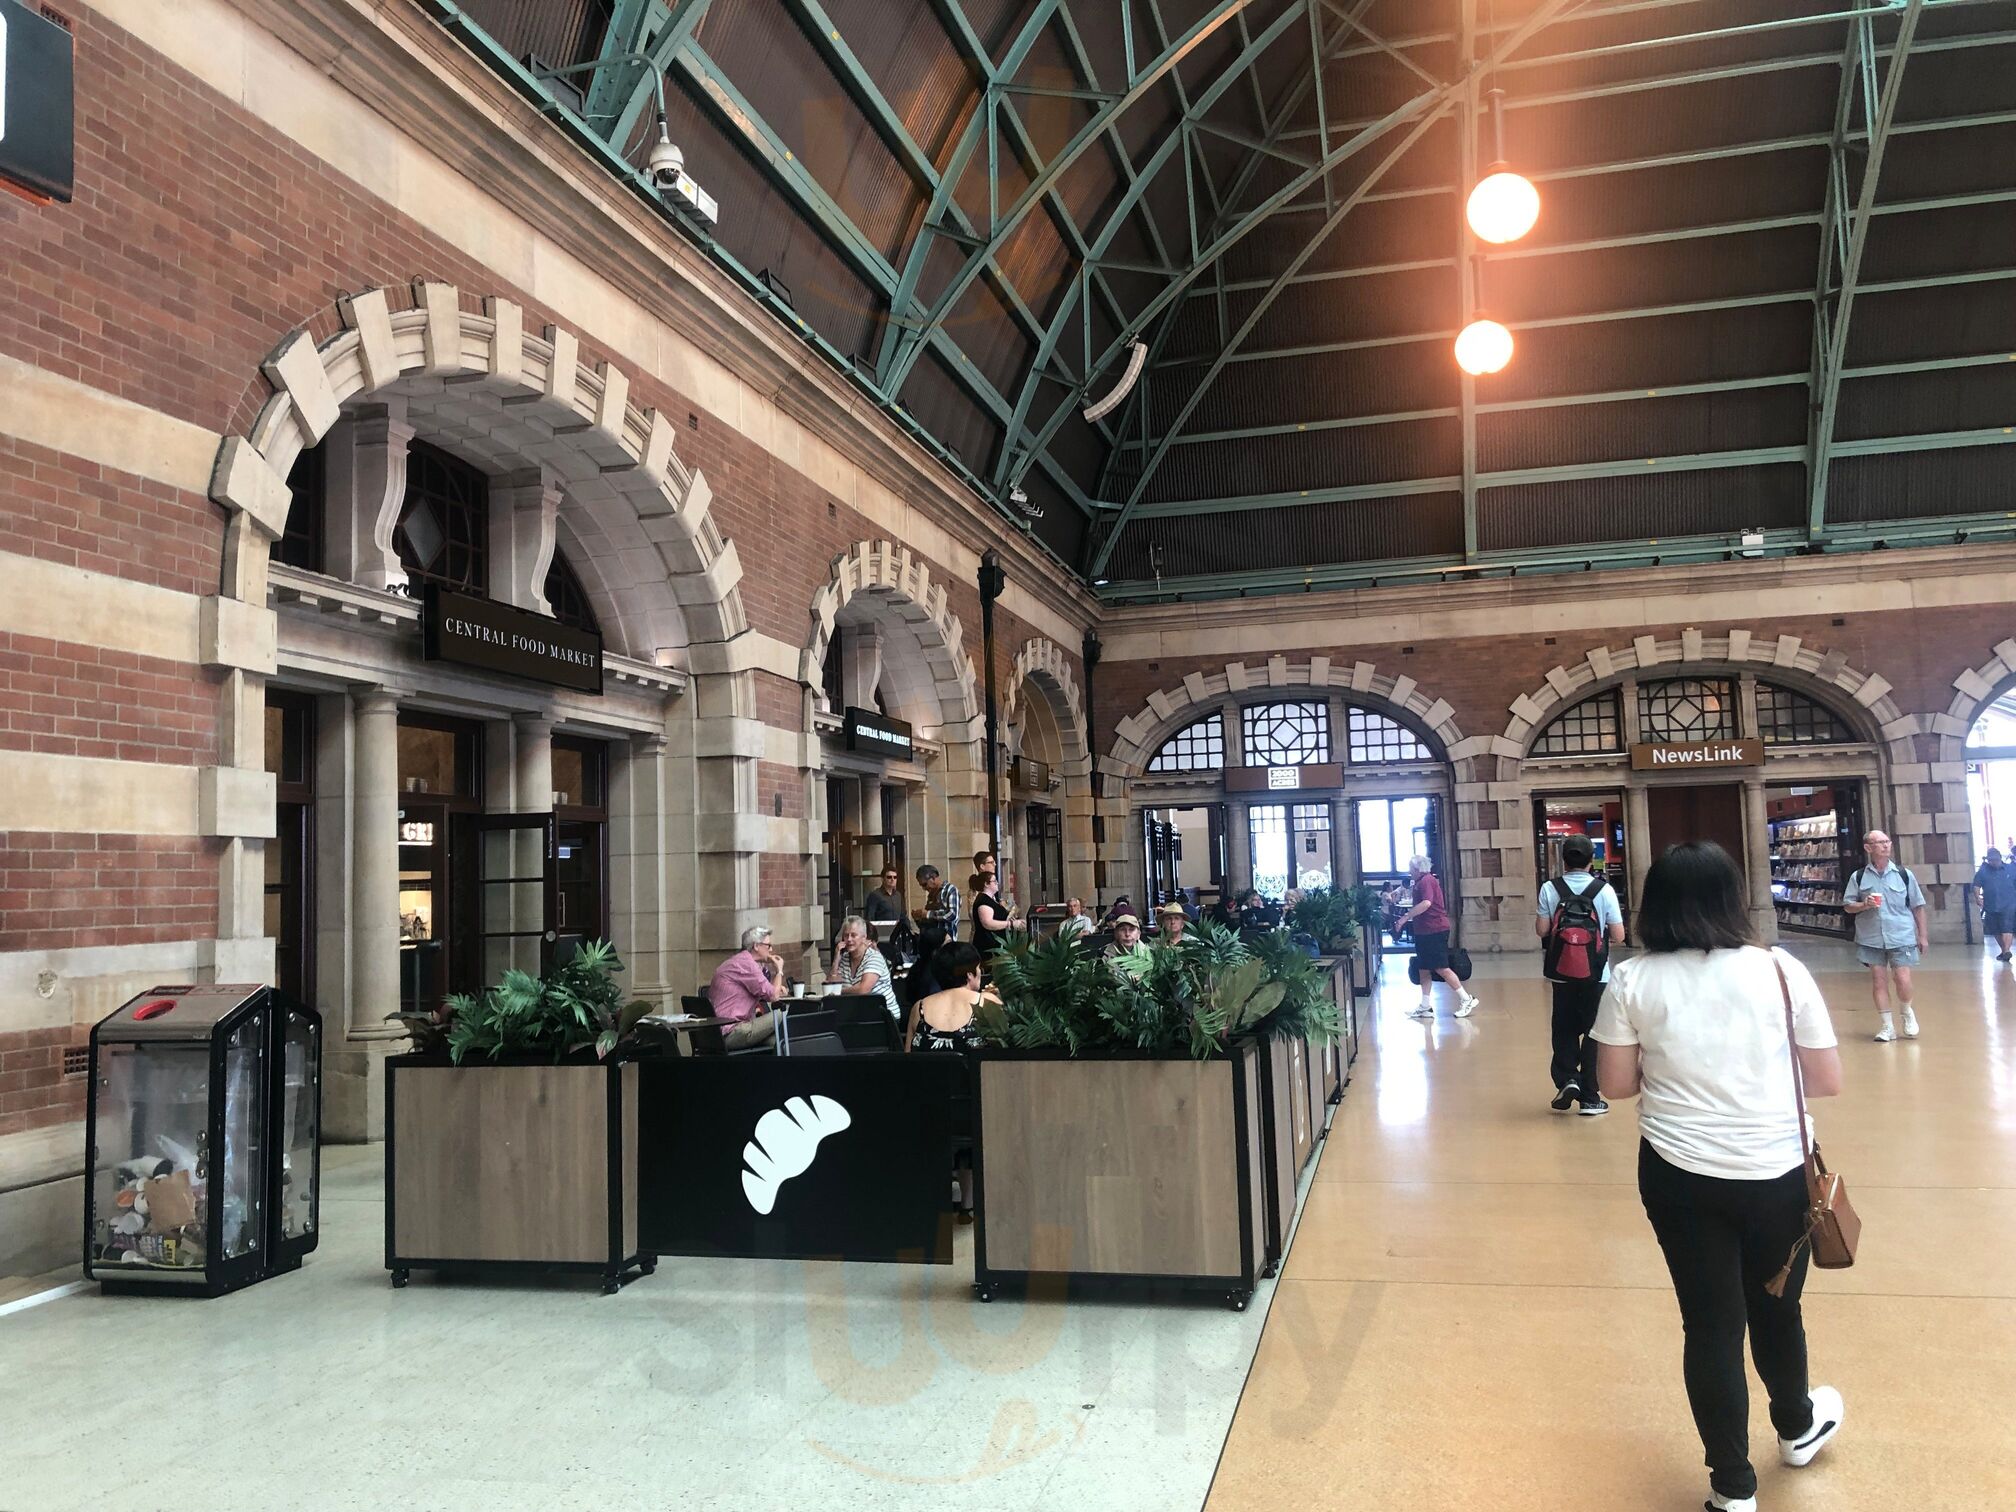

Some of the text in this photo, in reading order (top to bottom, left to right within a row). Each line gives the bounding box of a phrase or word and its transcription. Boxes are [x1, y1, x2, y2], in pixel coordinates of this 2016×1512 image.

[445, 617, 595, 668] CENTRAL FOOD MARKET
[856, 724, 878, 739] CENTRAL
[879, 730, 892, 742] FOOD
[1652, 745, 1743, 764] NewsLink
